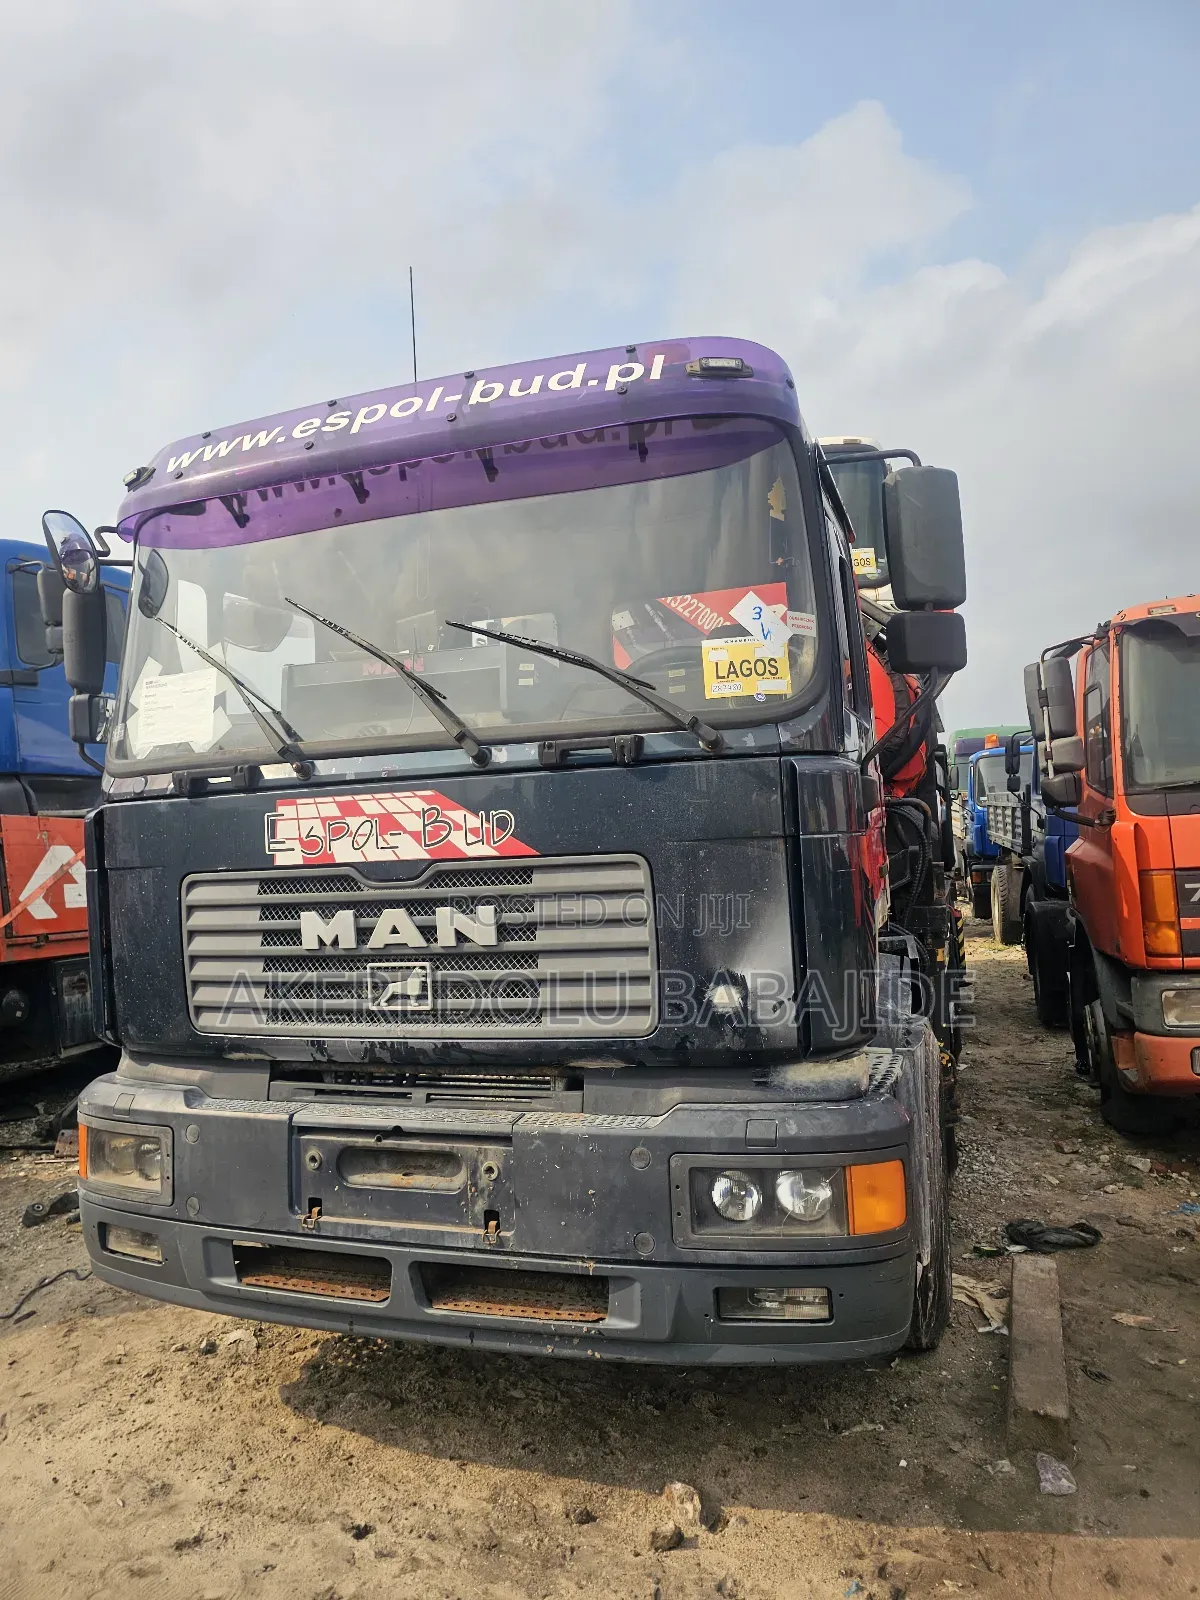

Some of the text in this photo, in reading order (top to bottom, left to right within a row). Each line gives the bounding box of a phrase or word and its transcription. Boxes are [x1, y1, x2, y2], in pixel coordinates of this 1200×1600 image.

[166, 354, 665, 473] www.espol-bud.pl
[752, 606, 763, 620] 3
[715, 657, 779, 680] LAGOS
[300, 904, 499, 950] MAN
